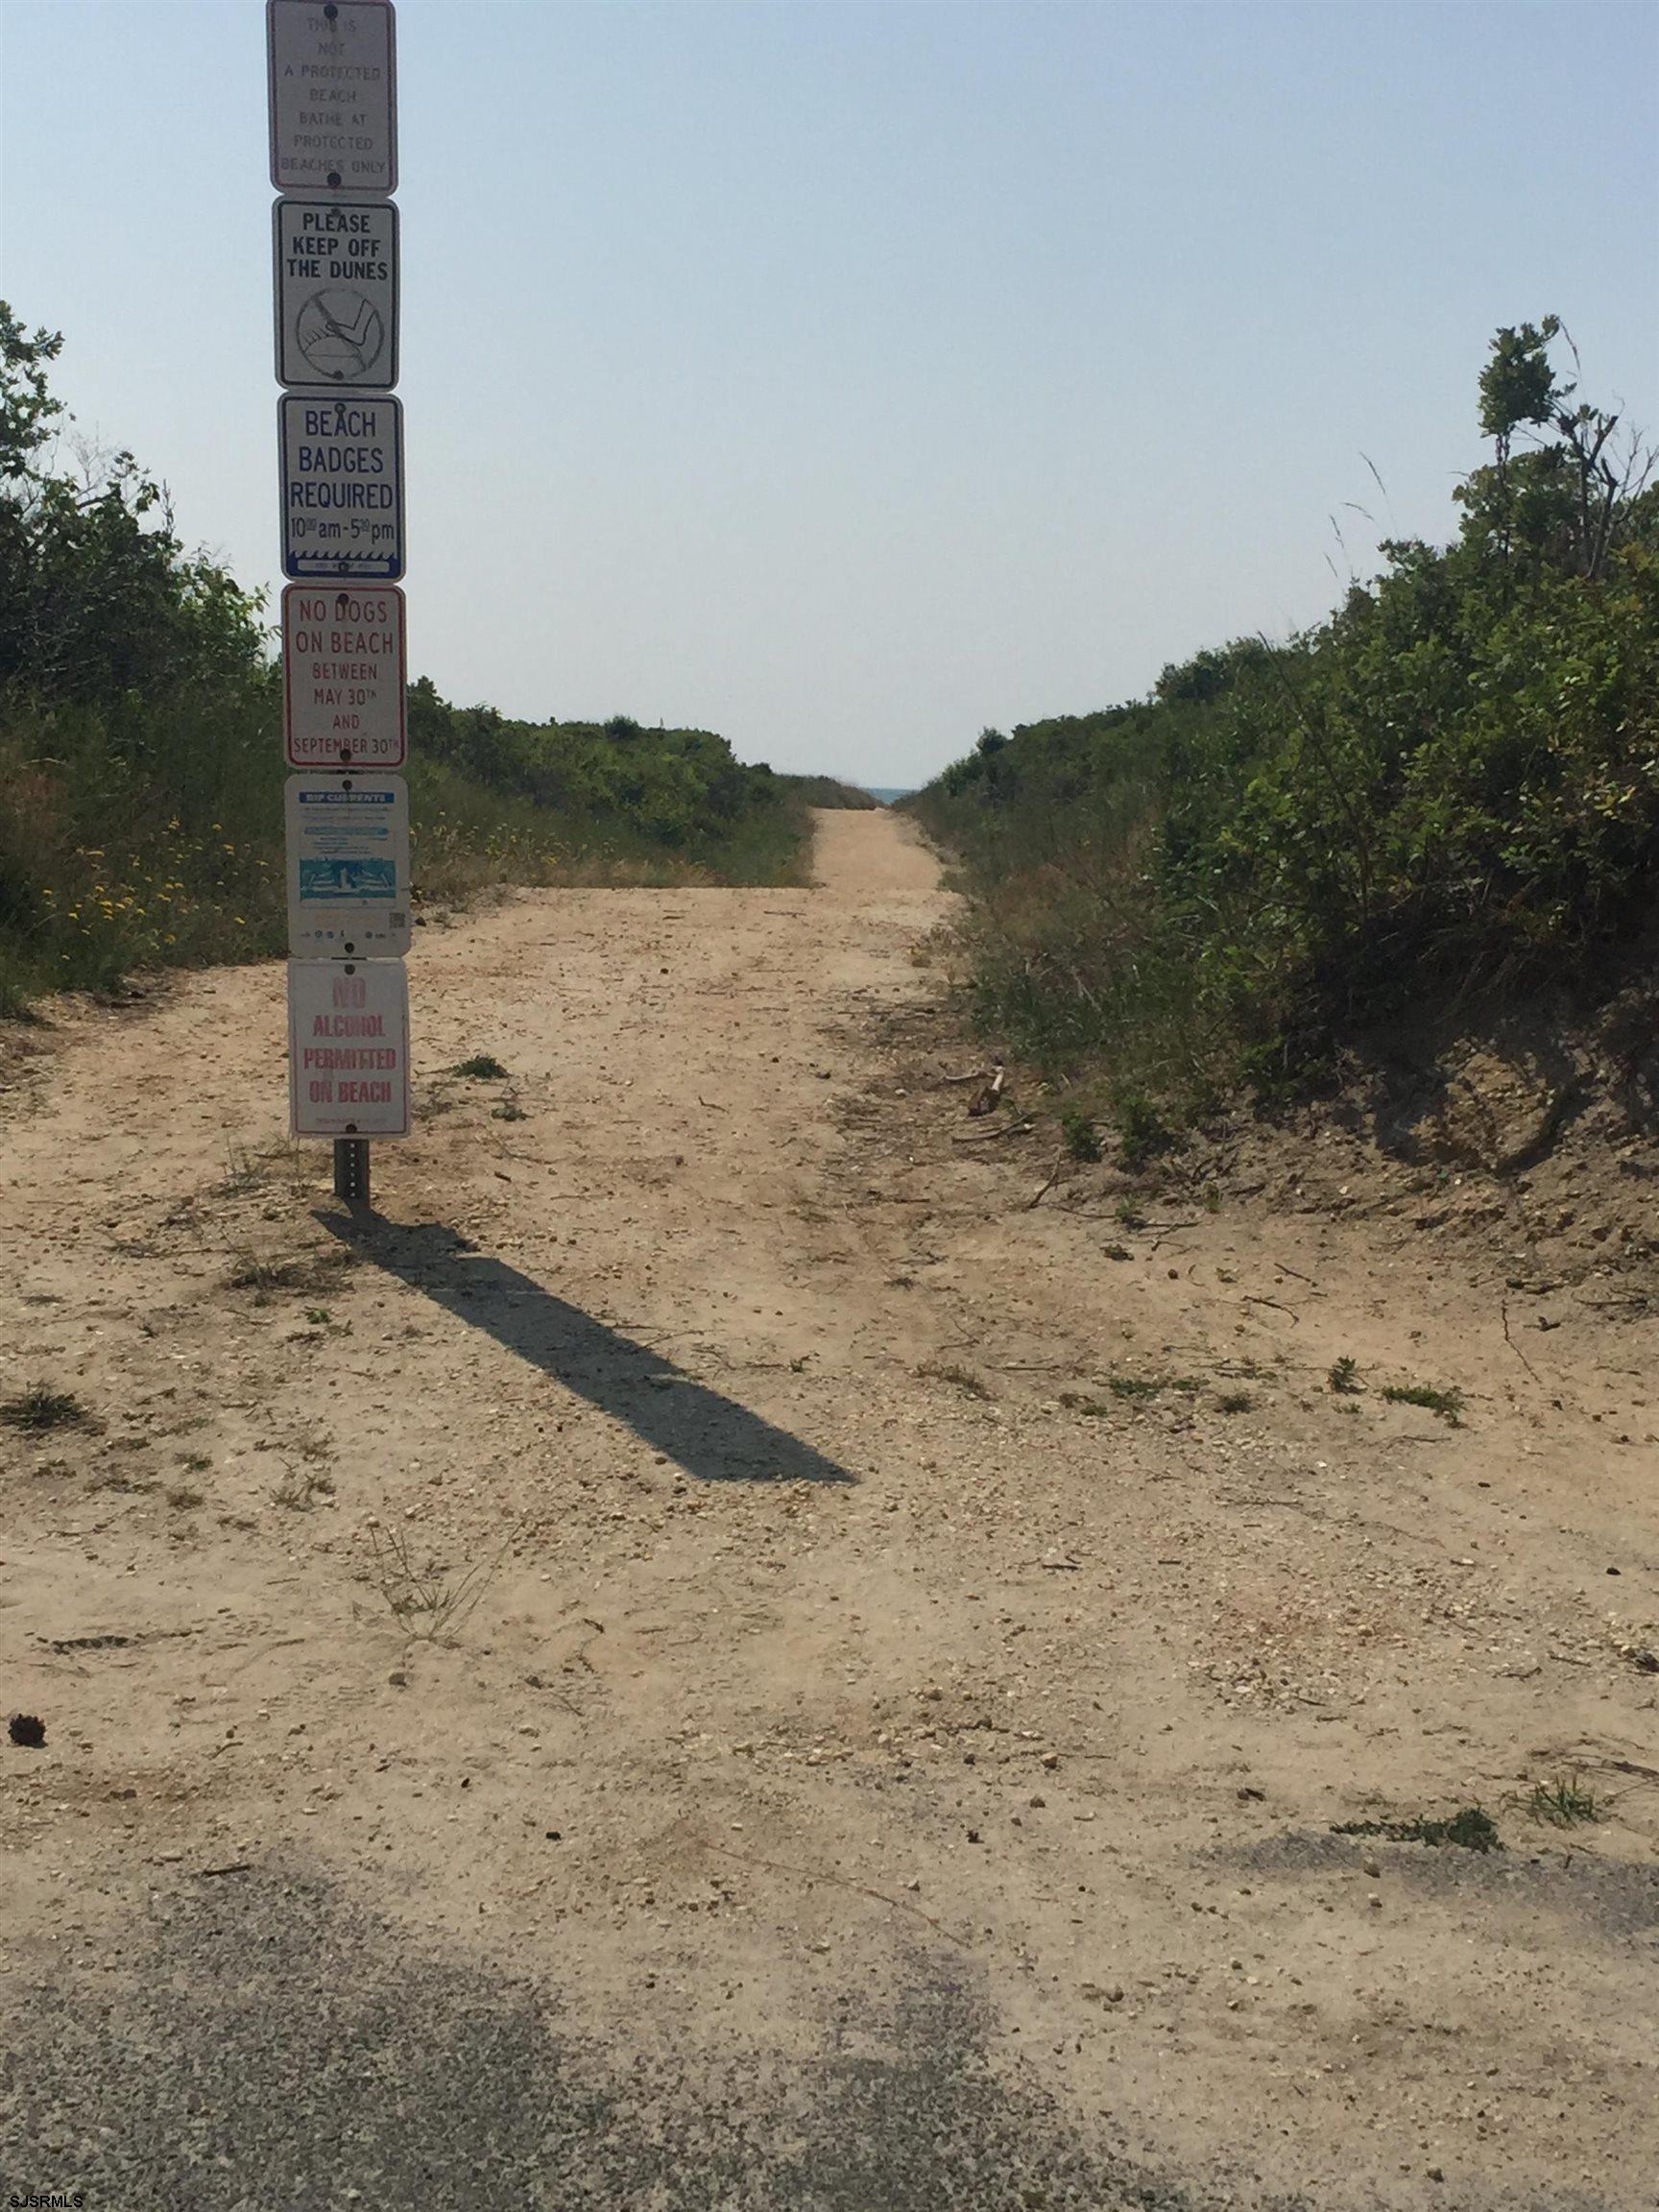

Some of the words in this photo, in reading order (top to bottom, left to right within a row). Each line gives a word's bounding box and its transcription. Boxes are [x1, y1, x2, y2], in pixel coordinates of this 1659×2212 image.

[307, 17, 336, 33] THIS
[344, 18, 356, 33] IS
[318, 42, 345, 56] NOT
[284, 64, 294, 77] A
[301, 65, 380, 81] PROTECTED
[309, 88, 356, 103] BEACH
[300, 111, 342, 126] BATHE
[351, 113, 367, 126] AT
[294, 134, 373, 151] PROTECTED
[281, 157, 344, 173] BEACHES
[351, 160, 386, 174] ONLY
[302, 212, 371, 233] PLEASE
[293, 236, 338, 255] KEEP
[349, 239, 381, 256] OFF
[287, 258, 321, 277] THE
[330, 261, 388, 280] DUNES
[305, 410, 376, 437] BEACH
[299, 446, 383, 473] BADGES
[290, 482, 393, 509] REQUIRED
[300, 600, 326, 622] NO
[336, 600, 388, 623] DOGS
[296, 631, 323, 653] ON
[331, 632, 394, 654] BEACH
[312, 662, 377, 680] BETWEEN
[314, 688, 342, 705] MAY
[349, 688, 377, 706] 30TH
[332, 714, 360, 730] AND
[294, 737, 368, 754] SEPTEMBER
[332, 976, 367, 1009] NO
[313, 1015, 386, 1038] ALCOHOL
[303, 1047, 397, 1070] PERMITTED
[309, 1080, 333, 1103] ON
[338, 1081, 392, 1103] BEACH
